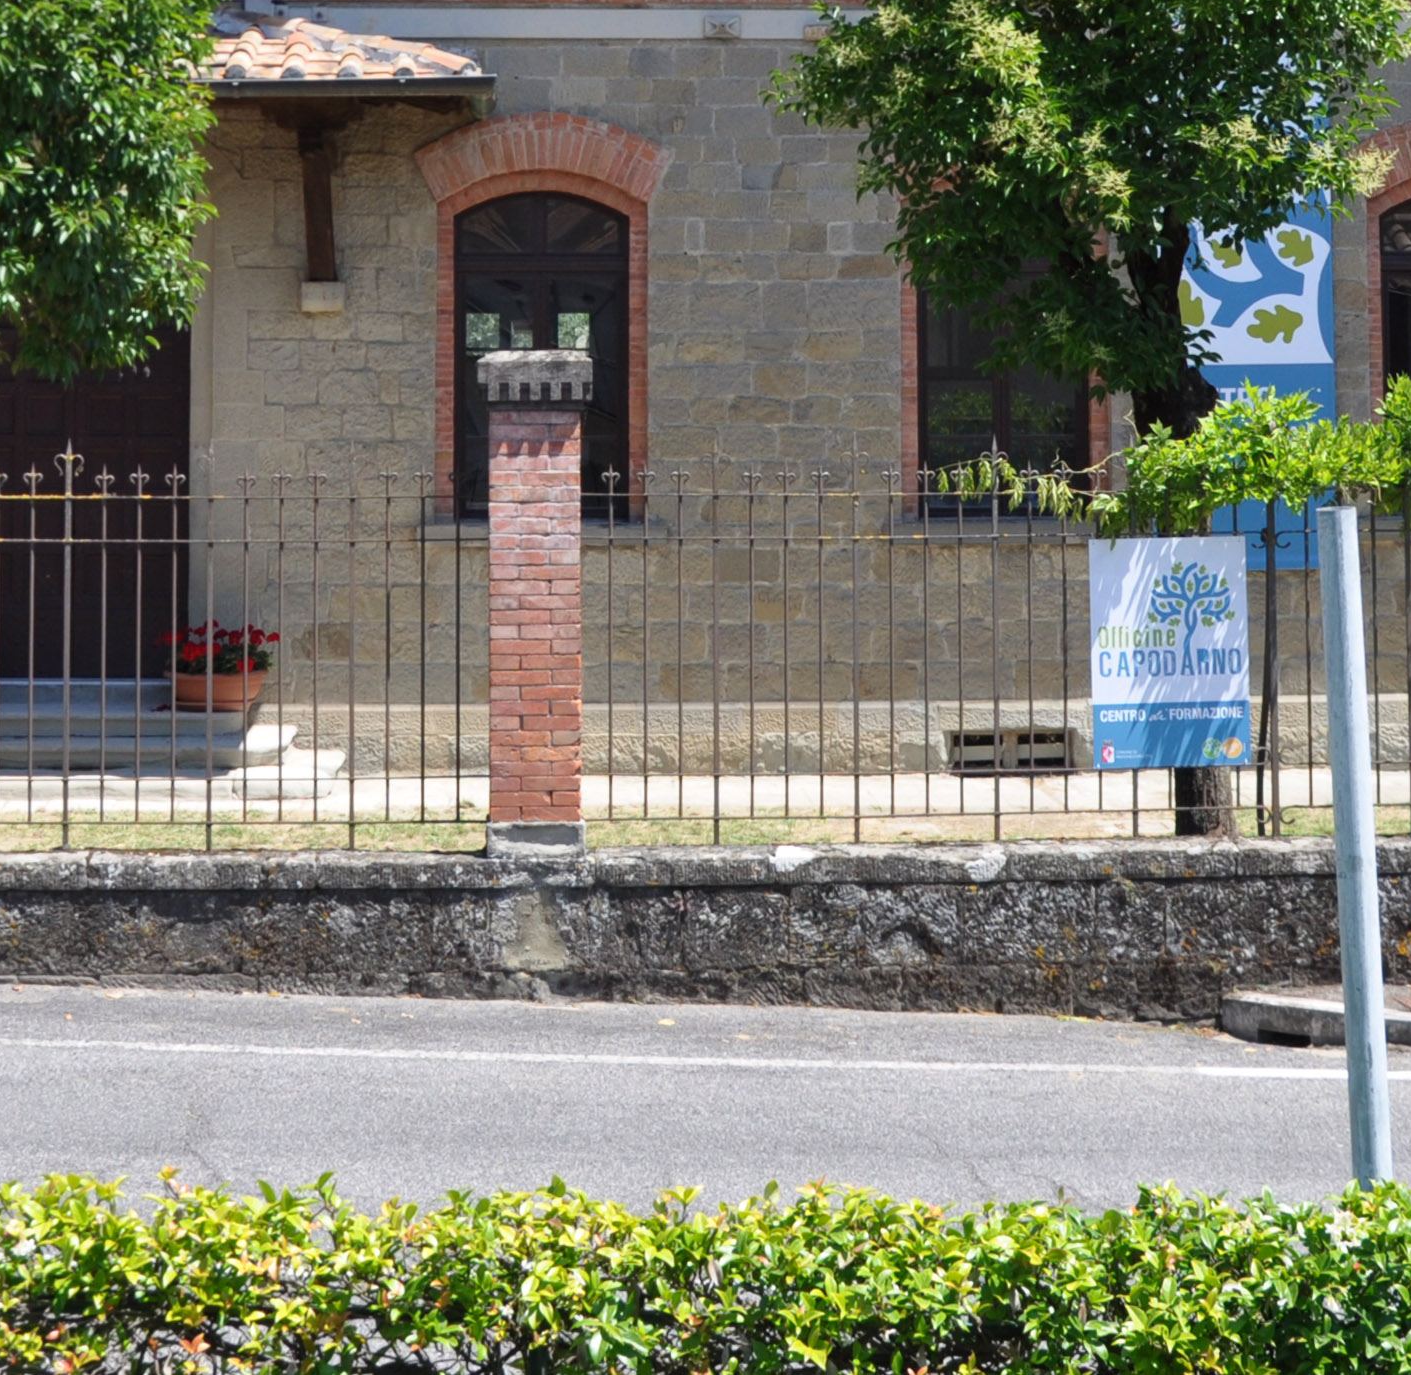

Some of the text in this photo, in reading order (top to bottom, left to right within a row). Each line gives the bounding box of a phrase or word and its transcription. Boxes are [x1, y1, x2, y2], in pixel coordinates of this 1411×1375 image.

[1098, 625, 1176, 649] Officine
[1099, 648, 1242, 677] CAPODARNO
[1099, 709, 1146, 723] CENTRO
[1169, 706, 1244, 720] FORMAZIONE
